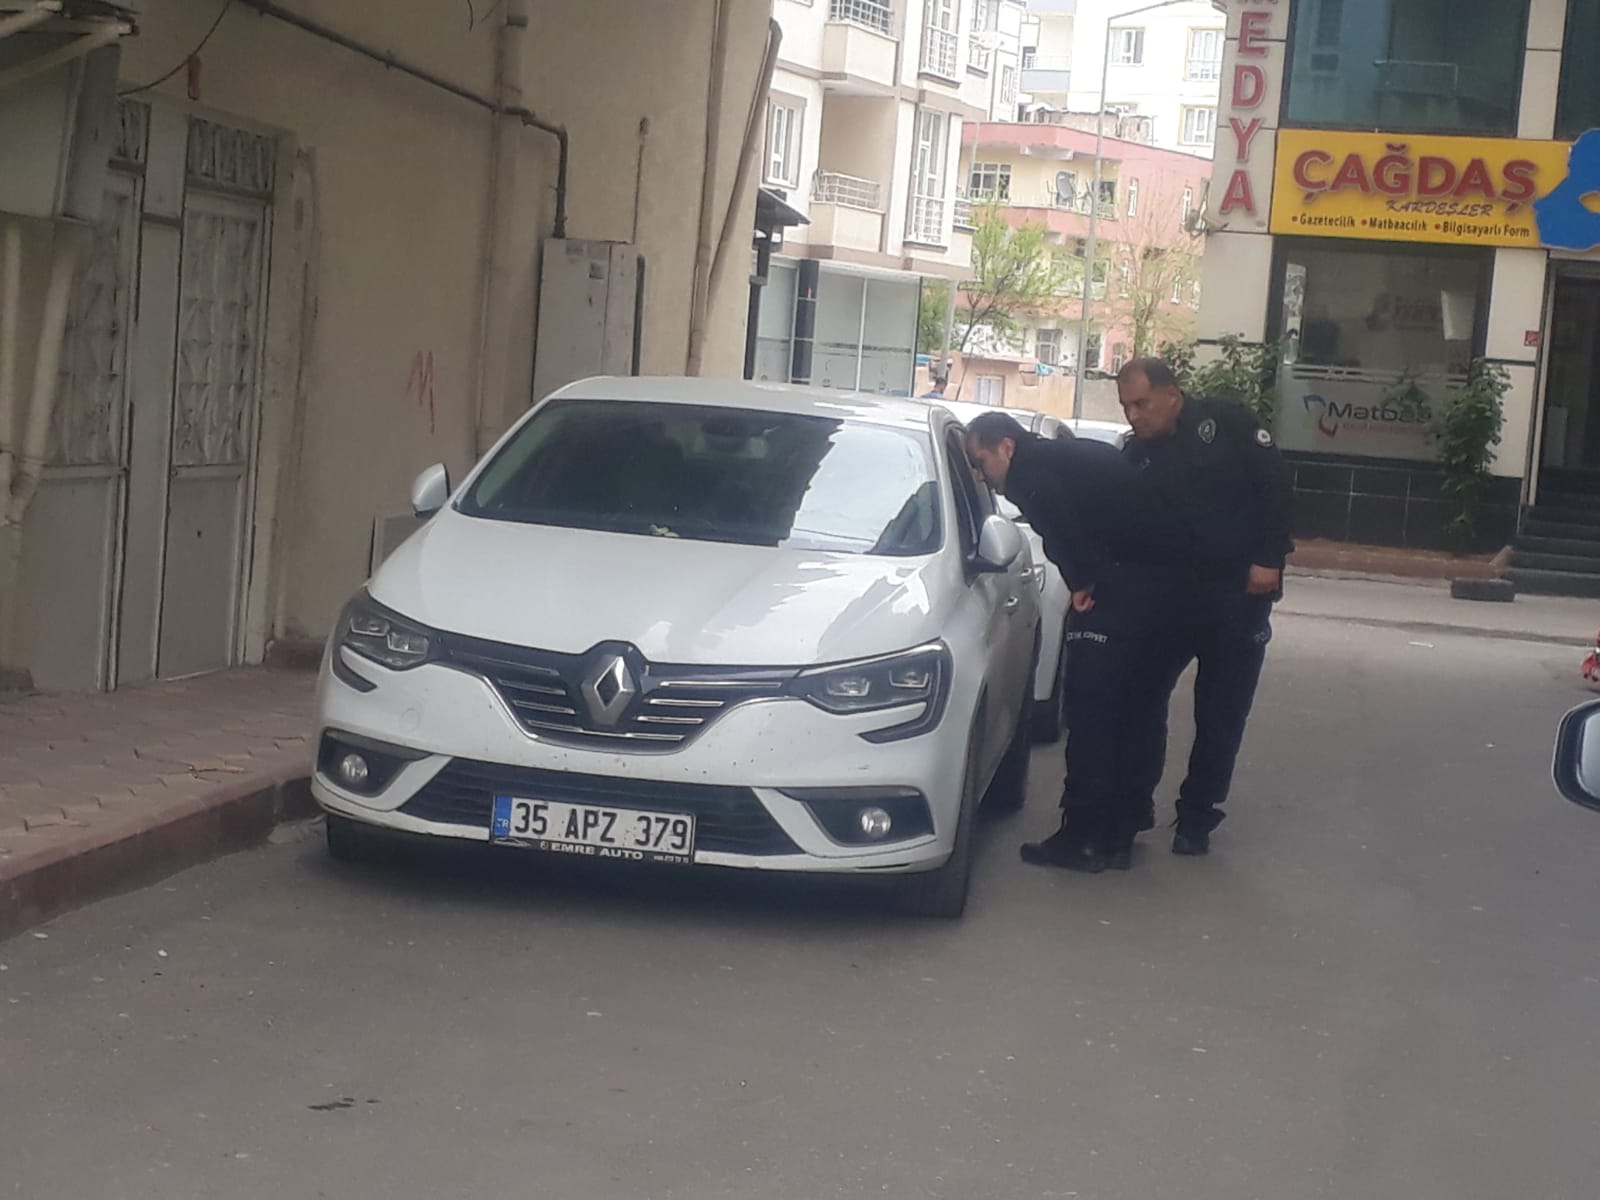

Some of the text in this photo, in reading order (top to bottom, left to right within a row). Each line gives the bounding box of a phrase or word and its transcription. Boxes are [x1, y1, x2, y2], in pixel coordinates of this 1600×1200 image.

[1219, 0, 1279, 216] EDYA
[1293, 142, 1538, 214] ÇAĞDAŞ
[1299, 213, 1356, 228] Gazetecilik
[1503, 224, 1530, 238] Form
[1384, 199, 1495, 217] KARDEŞLER
[514, 802, 549, 836] 35
[565, 808, 618, 845] APZ
[634, 815, 688, 850] 379
[551, 842, 595, 856] EMRE
[599, 845, 644, 861] AUTO
